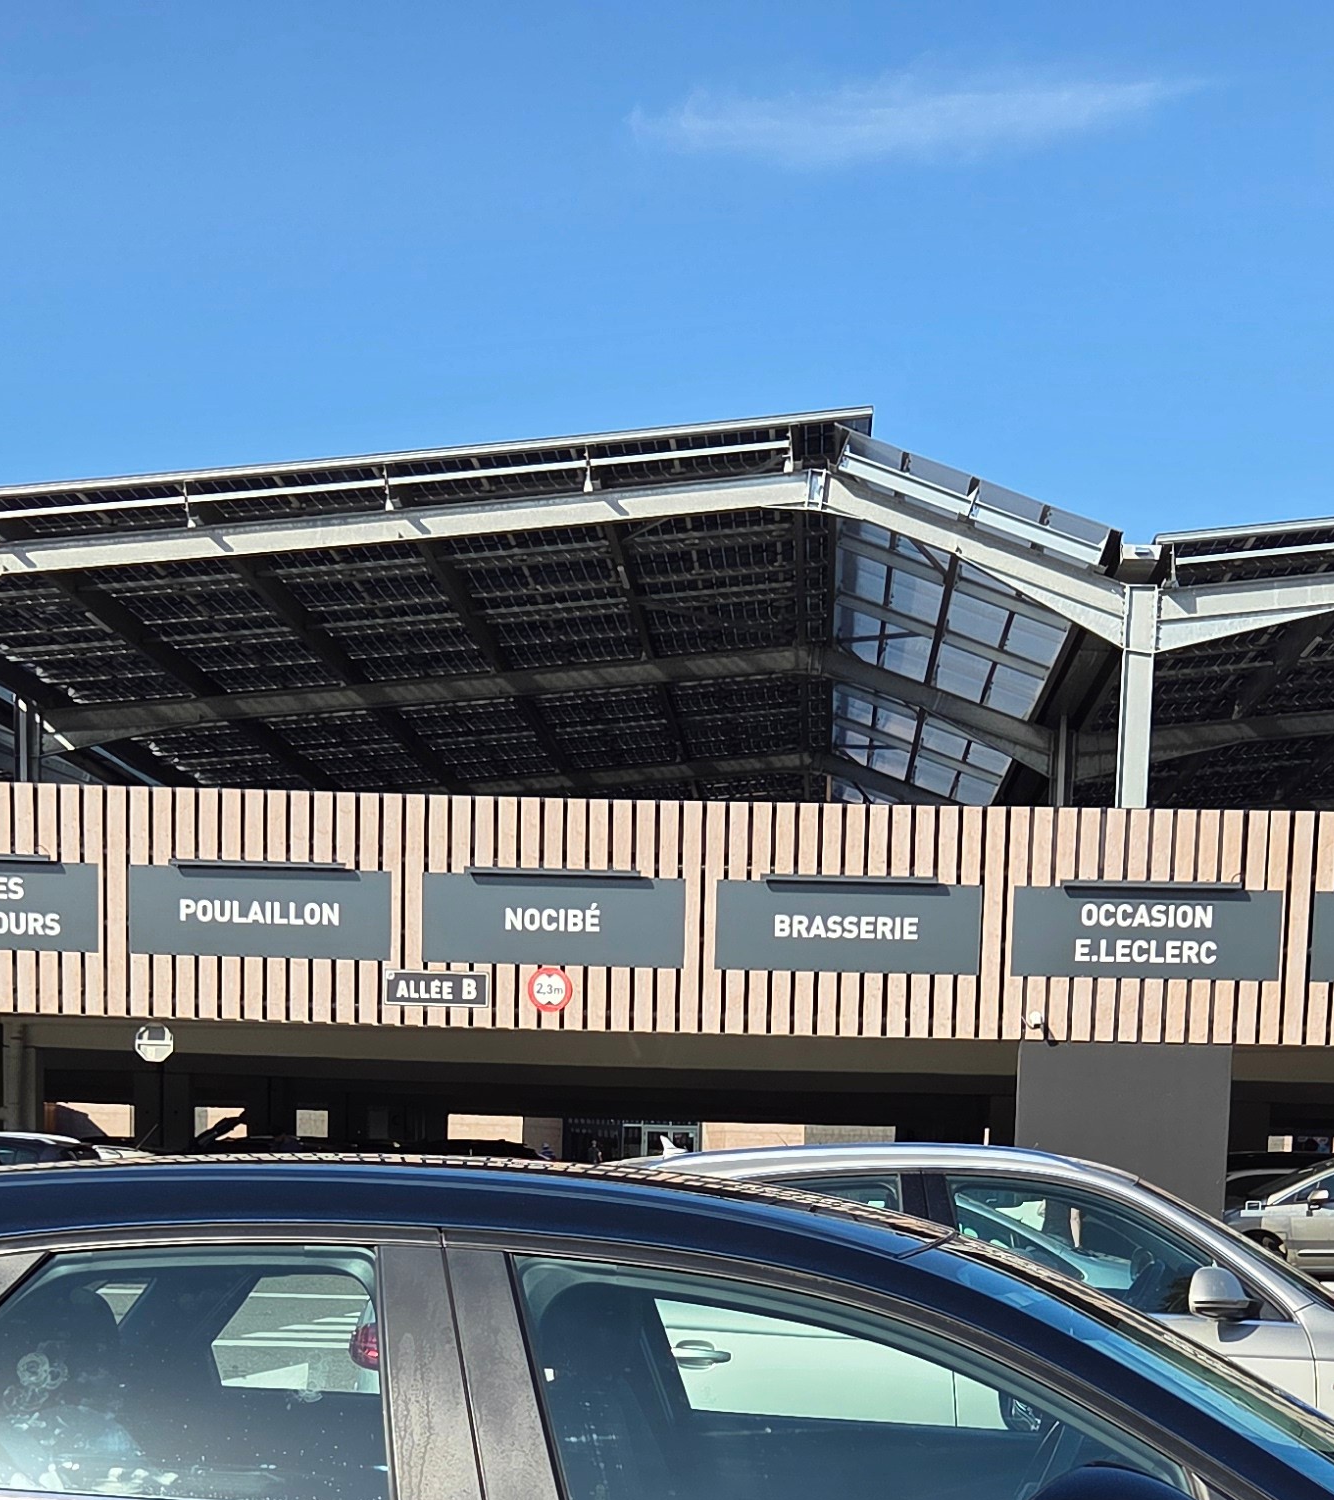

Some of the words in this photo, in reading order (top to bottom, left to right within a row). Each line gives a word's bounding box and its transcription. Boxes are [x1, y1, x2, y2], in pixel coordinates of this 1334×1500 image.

[180, 898, 340, 926] POULAILLON
[504, 903, 601, 932] NOCIBÉ
[1081, 903, 1213, 929] OCCASION
[774, 914, 919, 940] BRASSERIE
[1074, 938, 1218, 965] E.LECLERC
[461, 978, 478, 999] B
